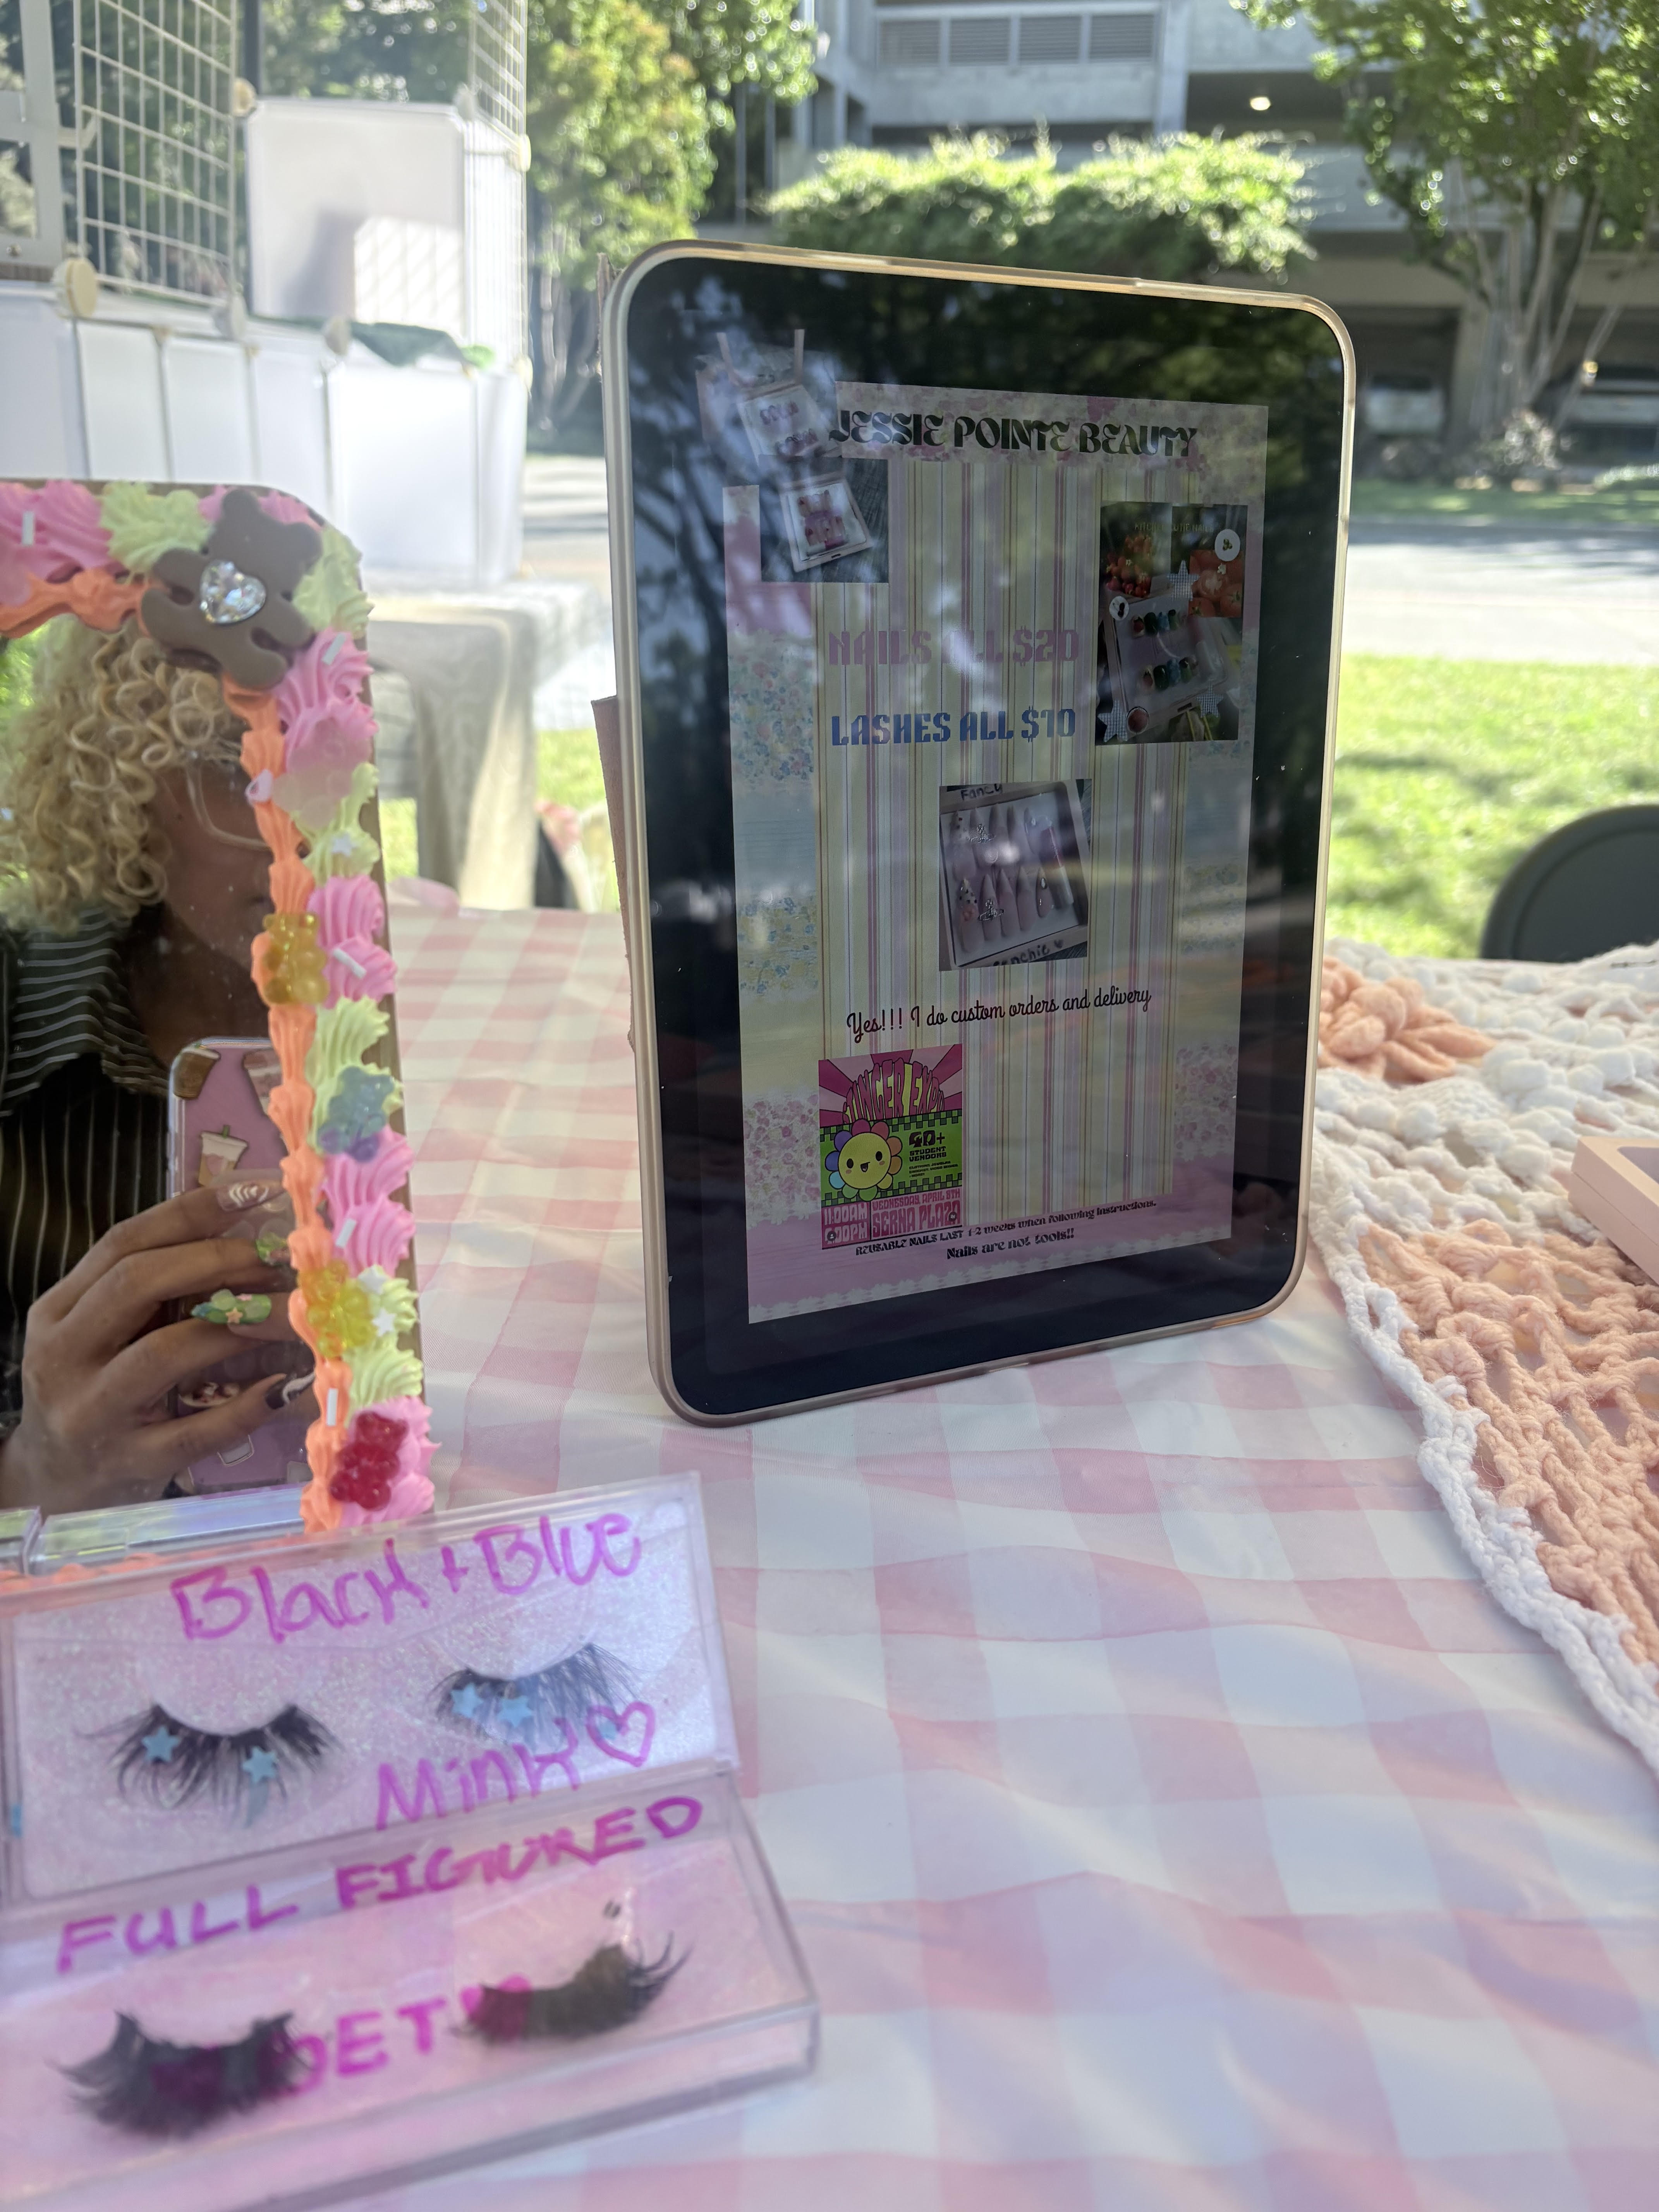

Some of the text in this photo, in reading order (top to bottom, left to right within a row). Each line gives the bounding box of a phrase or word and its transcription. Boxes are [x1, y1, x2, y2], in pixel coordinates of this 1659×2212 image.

[828, 410, 1198, 457] JESSIE POINTE BEAUTY
[1135, 521, 1165, 531] KITCHE
[829, 630, 932, 665] NAILS
[1012, 625, 1079, 667] $20
[831, 706, 1075, 746] LASHES ALL $10
[910, 1006, 920, 1027] I
[926, 1005, 948, 1026] do
[951, 1000, 1005, 1023] custom
[1009, 995, 1059, 1017] orders
[1063, 989, 1091, 1011] and
[1094, 985, 1151, 1012] delivery
[909, 1152, 946, 1162] VENDORS
[910, 1146, 946, 1156] STUDENT
[923, 1190, 945, 1204] APRIL
[856, 1239, 907, 1255] REUSABLE
[910, 1234, 937, 1246] NAILS
[940, 1230, 963, 1242] LAST
[985, 1222, 1015, 1235] weeks
[1018, 1217, 1046, 1228] when
[1048, 1207, 1094, 1219] following
[872, 1200, 960, 1238] SERNA PLAZA
[947, 1228, 1074, 1259] Nails are not tools!!
[475, 1513, 642, 1595] Blue
[57, 1795, 702, 1974] FULL FIGURED
